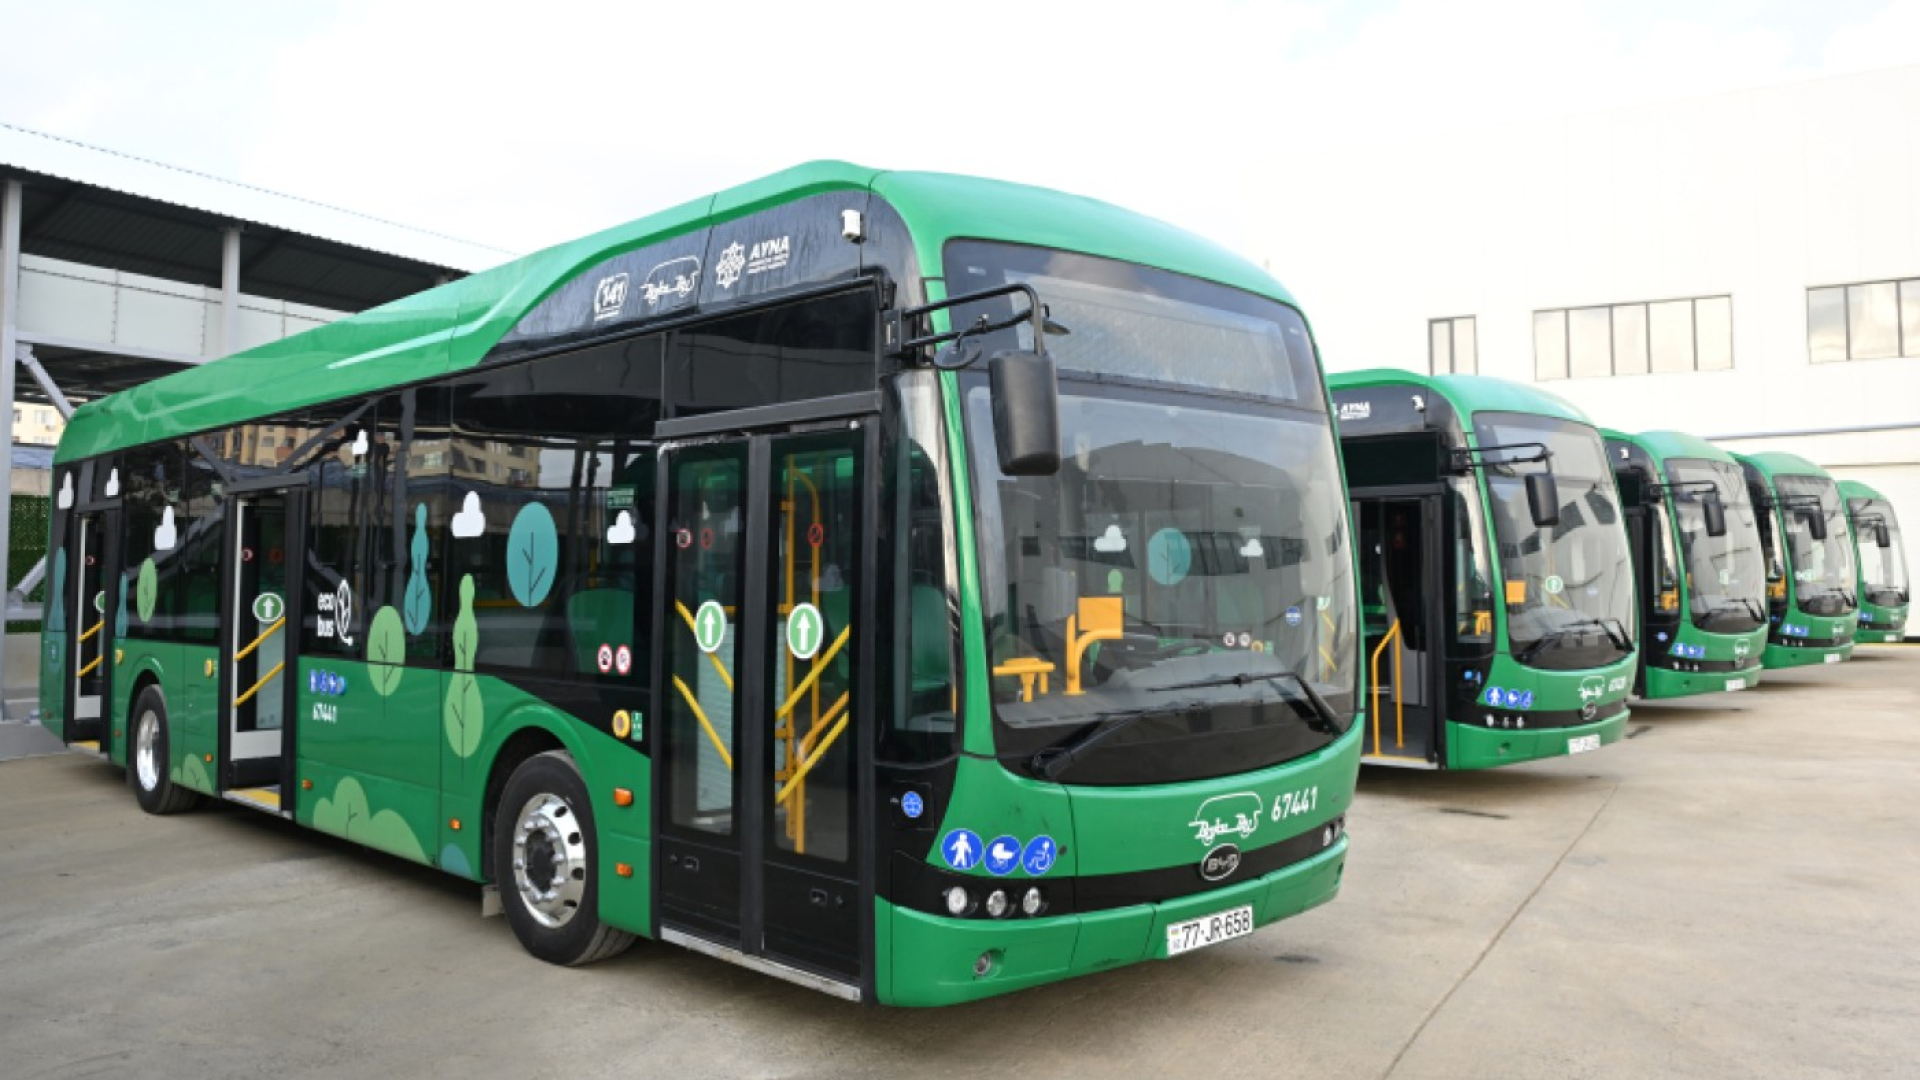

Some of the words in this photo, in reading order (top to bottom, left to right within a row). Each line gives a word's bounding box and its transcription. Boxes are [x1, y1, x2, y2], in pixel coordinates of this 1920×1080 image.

[749, 235, 789, 260] AYNA
[317, 593, 334, 611] eco
[317, 614, 334, 637] bus
[1271, 785, 1317, 822] 67441
[1206, 853, 1239, 872] BYD
